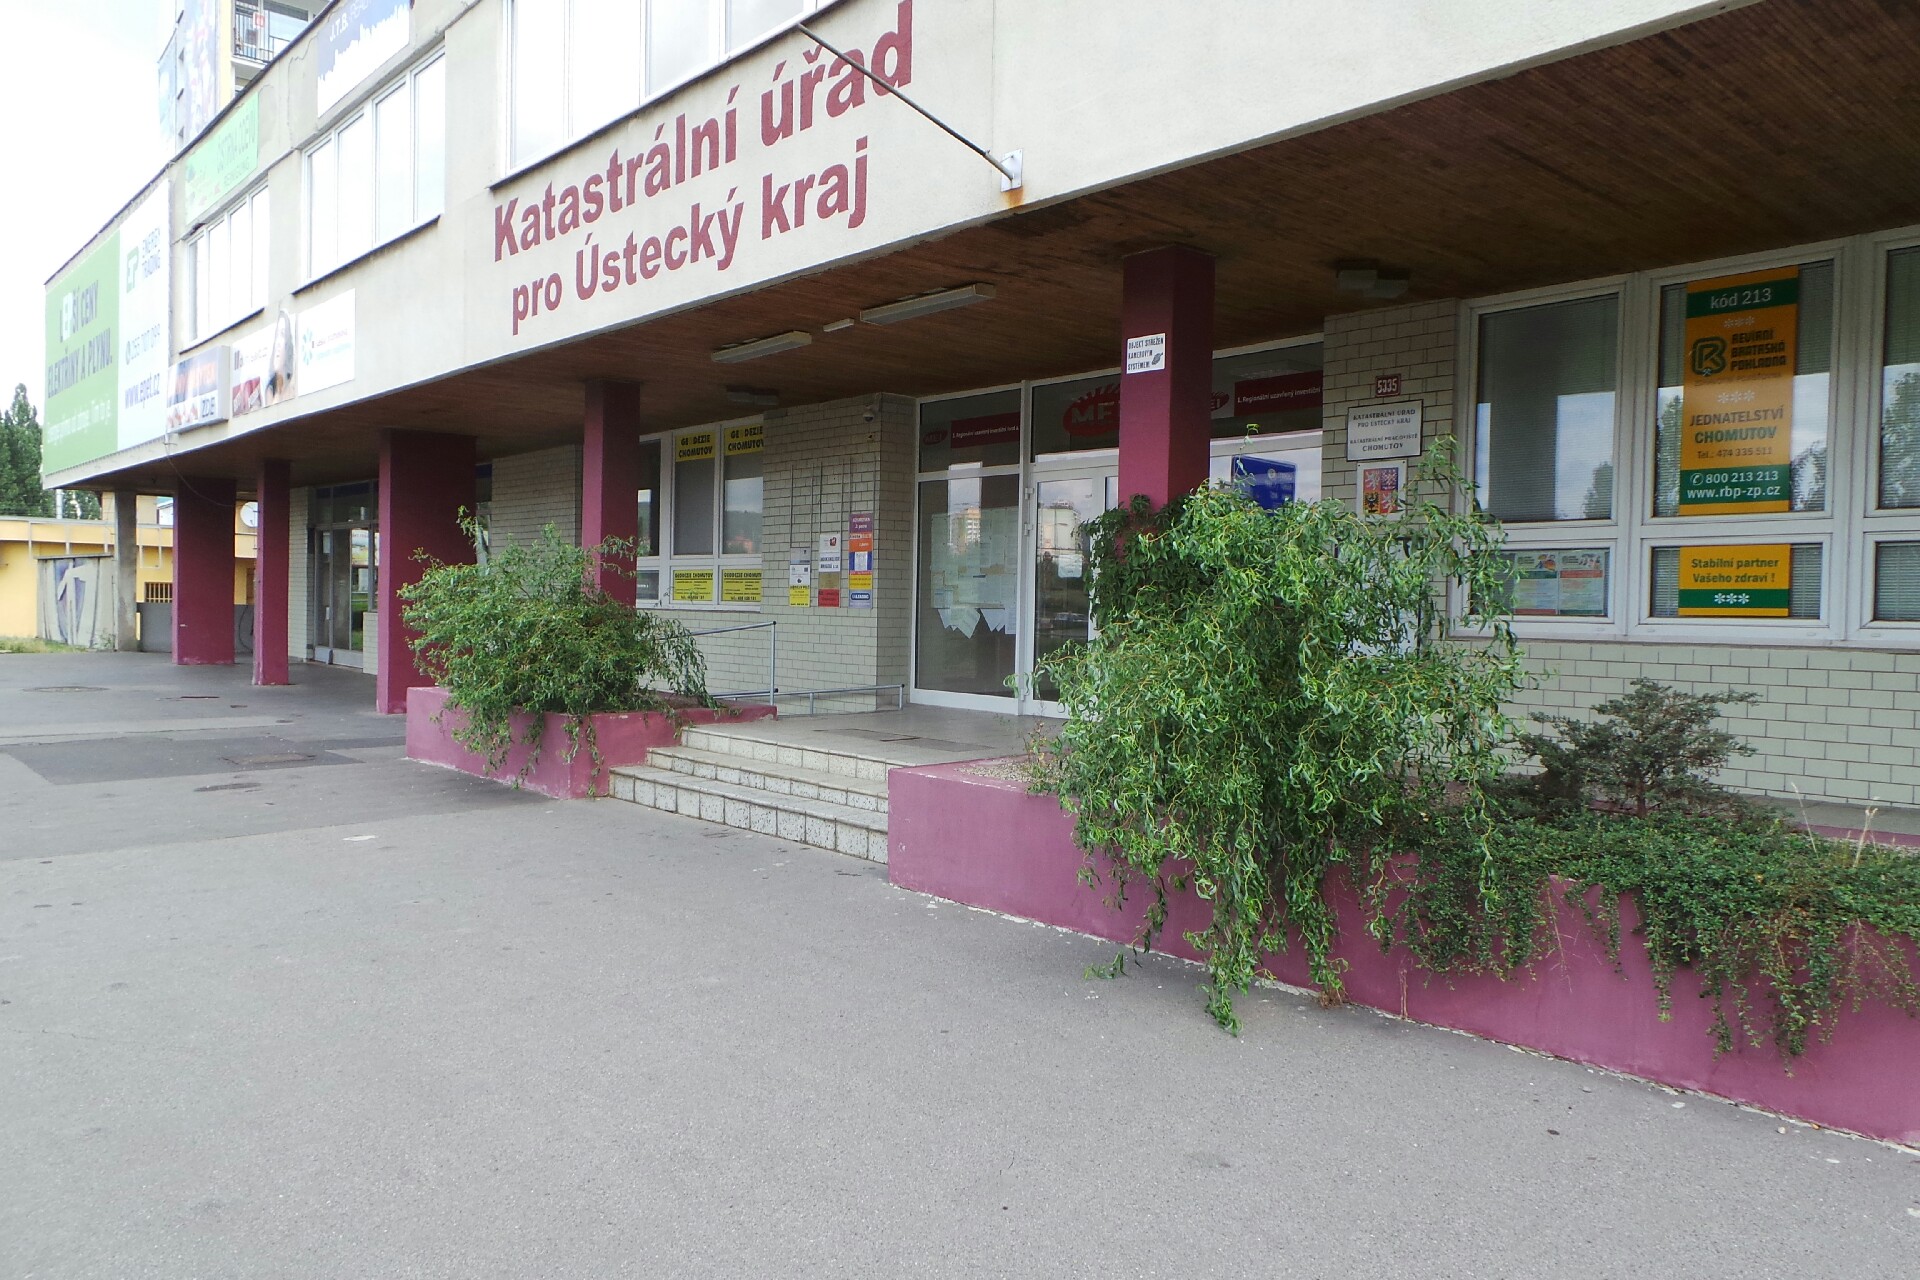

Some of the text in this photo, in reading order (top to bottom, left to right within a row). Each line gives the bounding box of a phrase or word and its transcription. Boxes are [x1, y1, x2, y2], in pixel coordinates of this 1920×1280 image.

[494, 0, 913, 262] Katastrální úřad
[512, 135, 868, 335] pro Ústecký kraj
[1710, 287, 1772, 309] kód 213
[1128, 340, 1144, 350] OBJEKT
[1377, 378, 1398, 394] 5335
[1689, 405, 1784, 426] JEDNATELSTVÍ
[1694, 426, 1777, 444] CHOMUTOV
[678, 446, 713, 458] CHOMUTOV
[1362, 443, 1404, 452] CHOMUTOV
[1705, 470, 1779, 484] 800 213 213
[1687, 485, 1781, 499] www.rbp-zp.cz
[1691, 557, 1779, 570] Stabilní partner
[1692, 572, 1733, 583] Vašeho
[1735, 572, 1768, 583] zdraví
